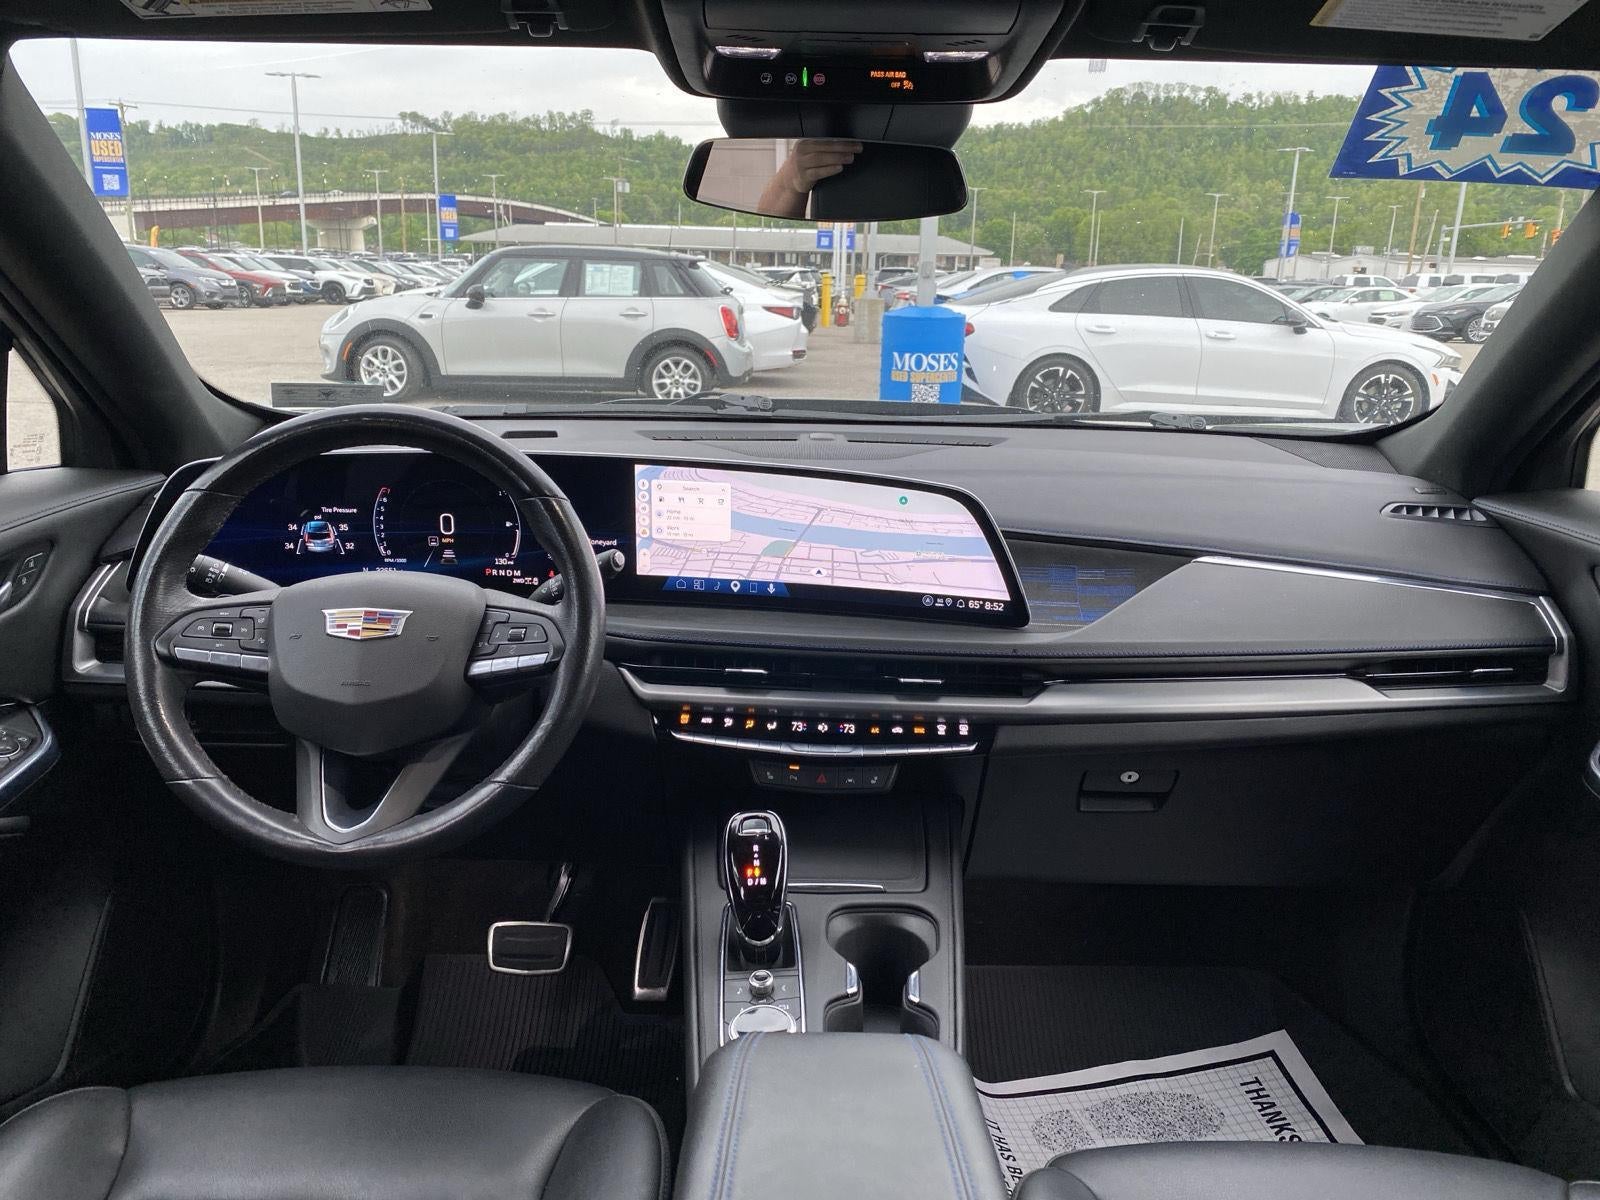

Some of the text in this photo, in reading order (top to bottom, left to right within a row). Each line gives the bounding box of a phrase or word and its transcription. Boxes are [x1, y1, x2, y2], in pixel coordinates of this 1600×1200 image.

[90, 131, 121, 140] MOSES
[91, 140, 123, 156] USED
[892, 351, 959, 372] MOSES
[333, 506, 357, 514] Pressure
[287, 523, 298, 531] 34
[338, 523, 349, 531] 35
[440, 513, 455, 535] 0
[284, 542, 295, 550] 34
[344, 542, 355, 550] 32
[984, 602, 1004, 611] 8:52
[791, 721, 803, 732] 73
[843, 723, 855, 734] 73
[991, 1134, 1017, 1162] HAS
